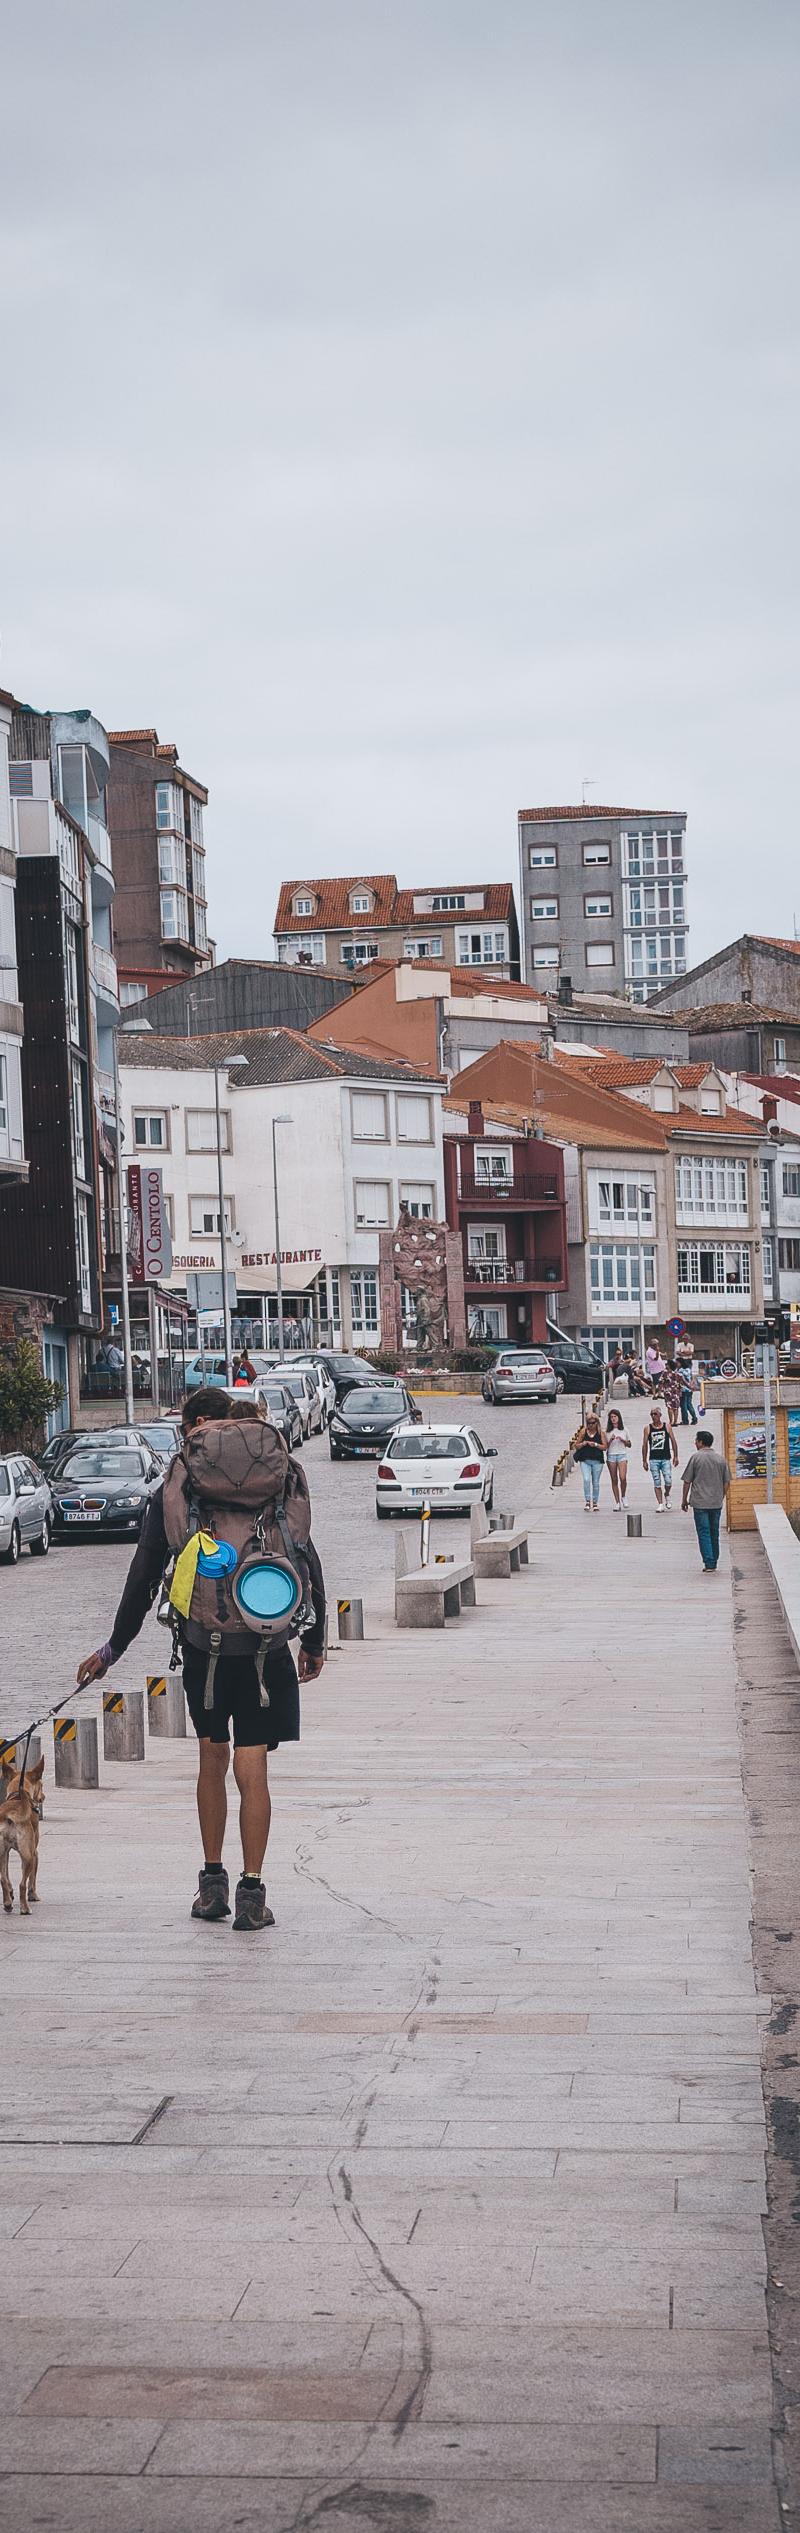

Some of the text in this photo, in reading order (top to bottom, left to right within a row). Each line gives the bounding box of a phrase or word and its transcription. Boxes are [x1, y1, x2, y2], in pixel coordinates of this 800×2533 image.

[131, 1174, 139, 1214] URANTE
[147, 1259, 163, 1275] O
[241, 1249, 322, 1267] RESTAURANTE
